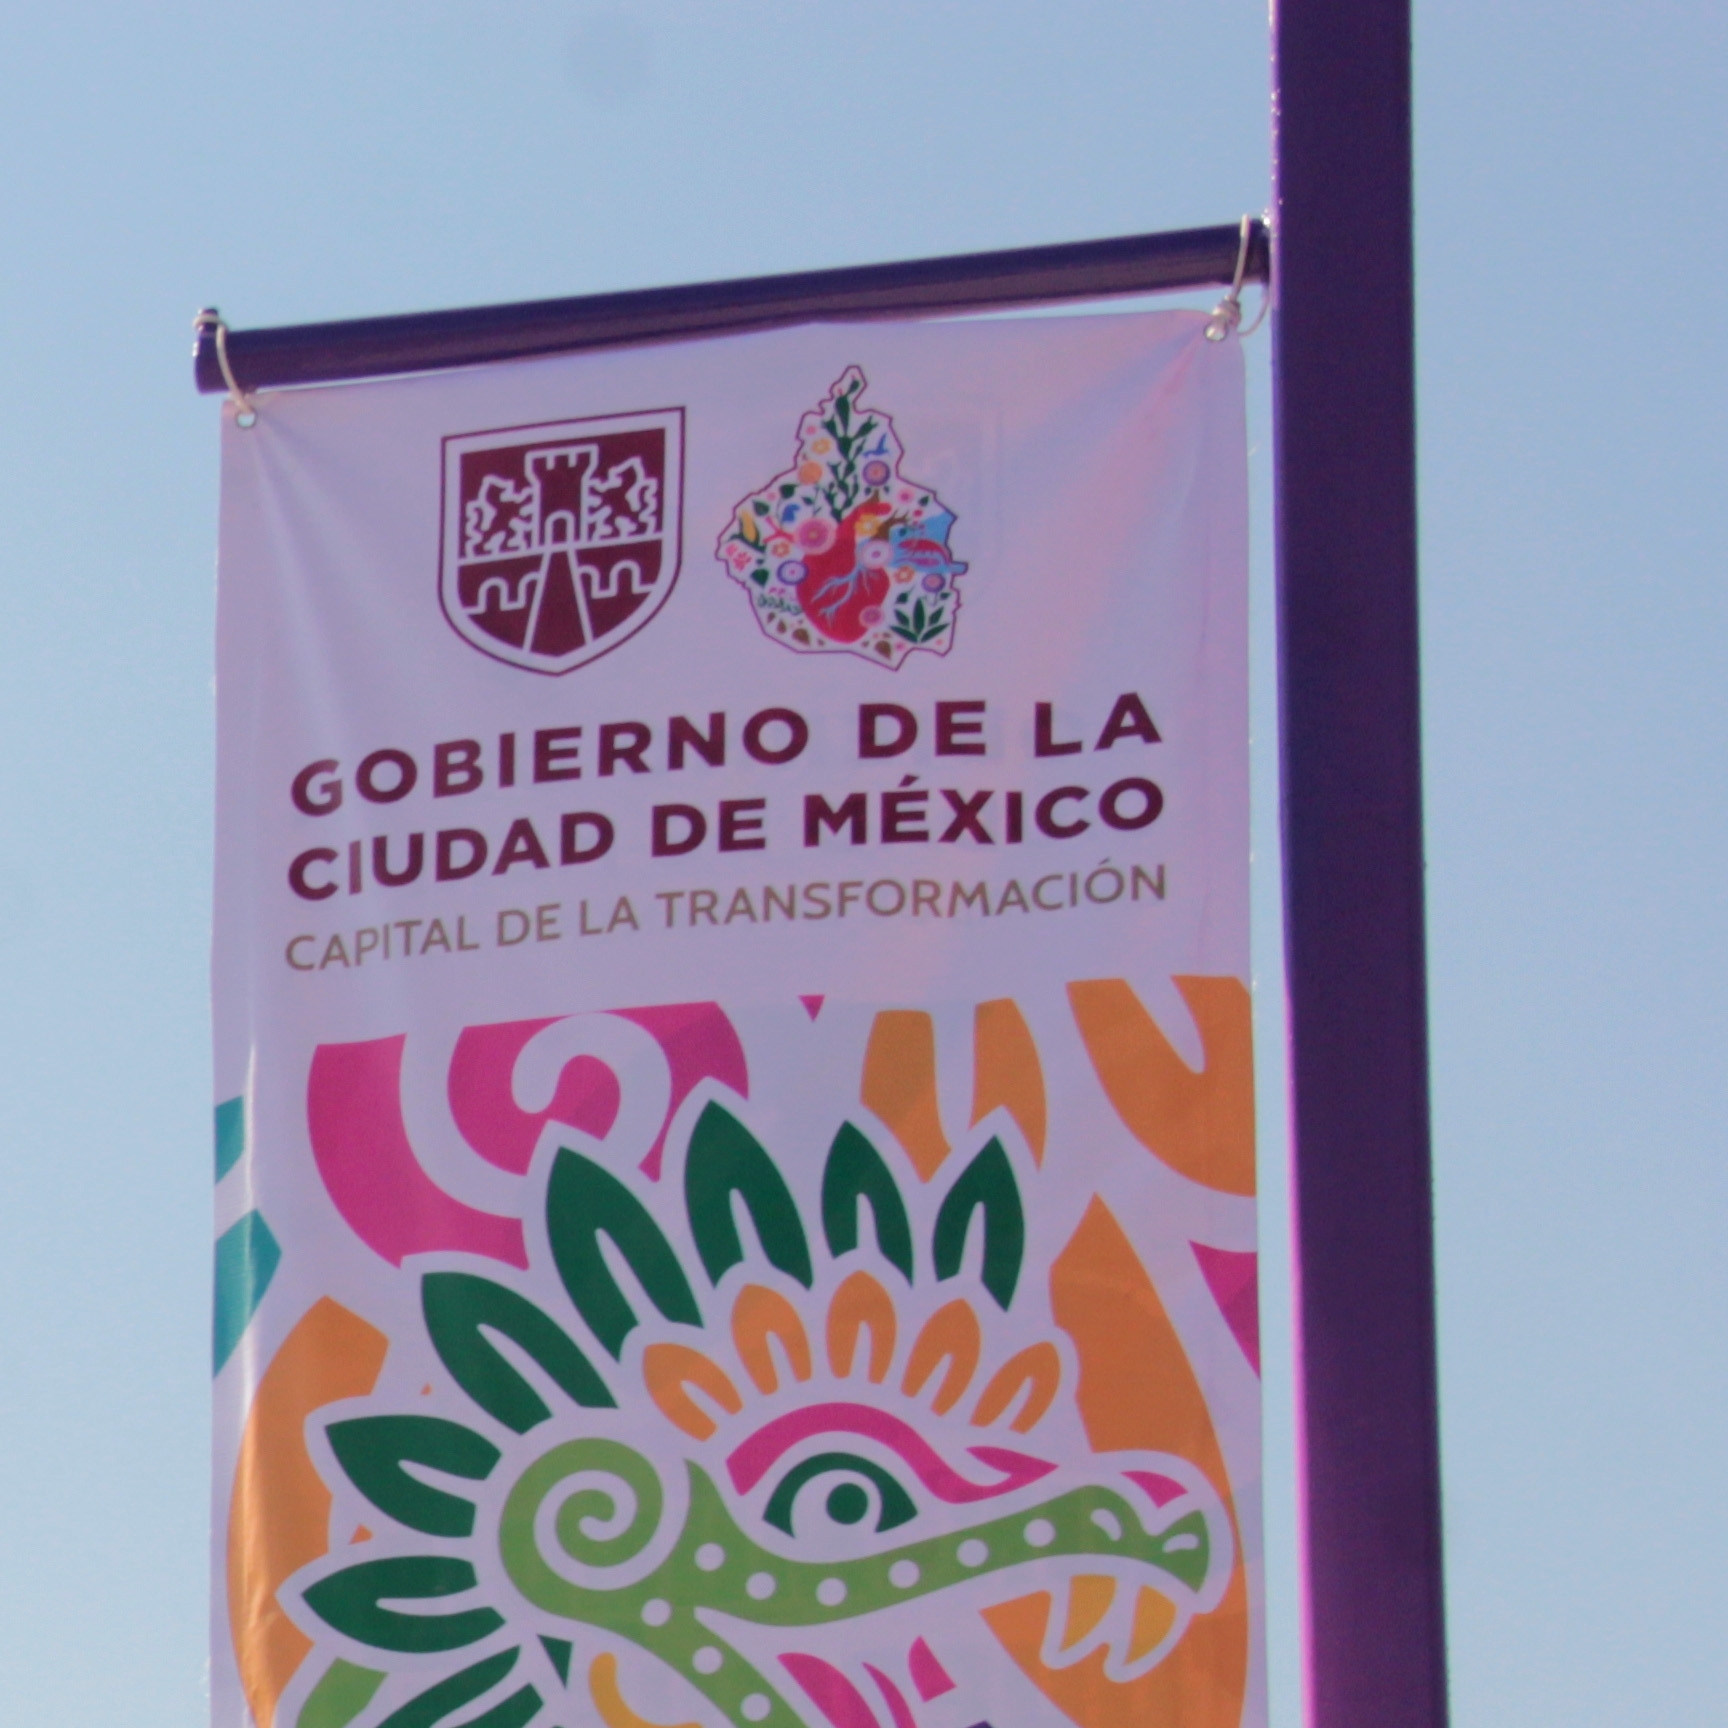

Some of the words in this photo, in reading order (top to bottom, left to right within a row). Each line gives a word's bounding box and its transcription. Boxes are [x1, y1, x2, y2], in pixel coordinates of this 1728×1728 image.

[291, 706, 808, 816] GOBIERNO
[857, 699, 986, 758] DE
[1033, 691, 1162, 757] LA
[288, 811, 614, 901] CIUDAD
[651, 798, 766, 857] DE
[803, 775, 1164, 847] MÉXICO
[285, 919, 479, 972] CAPITAL
[497, 905, 560, 945] DE
[580, 894, 639, 934] LA
[655, 858, 1167, 928] TRANSFORMACIÓN
